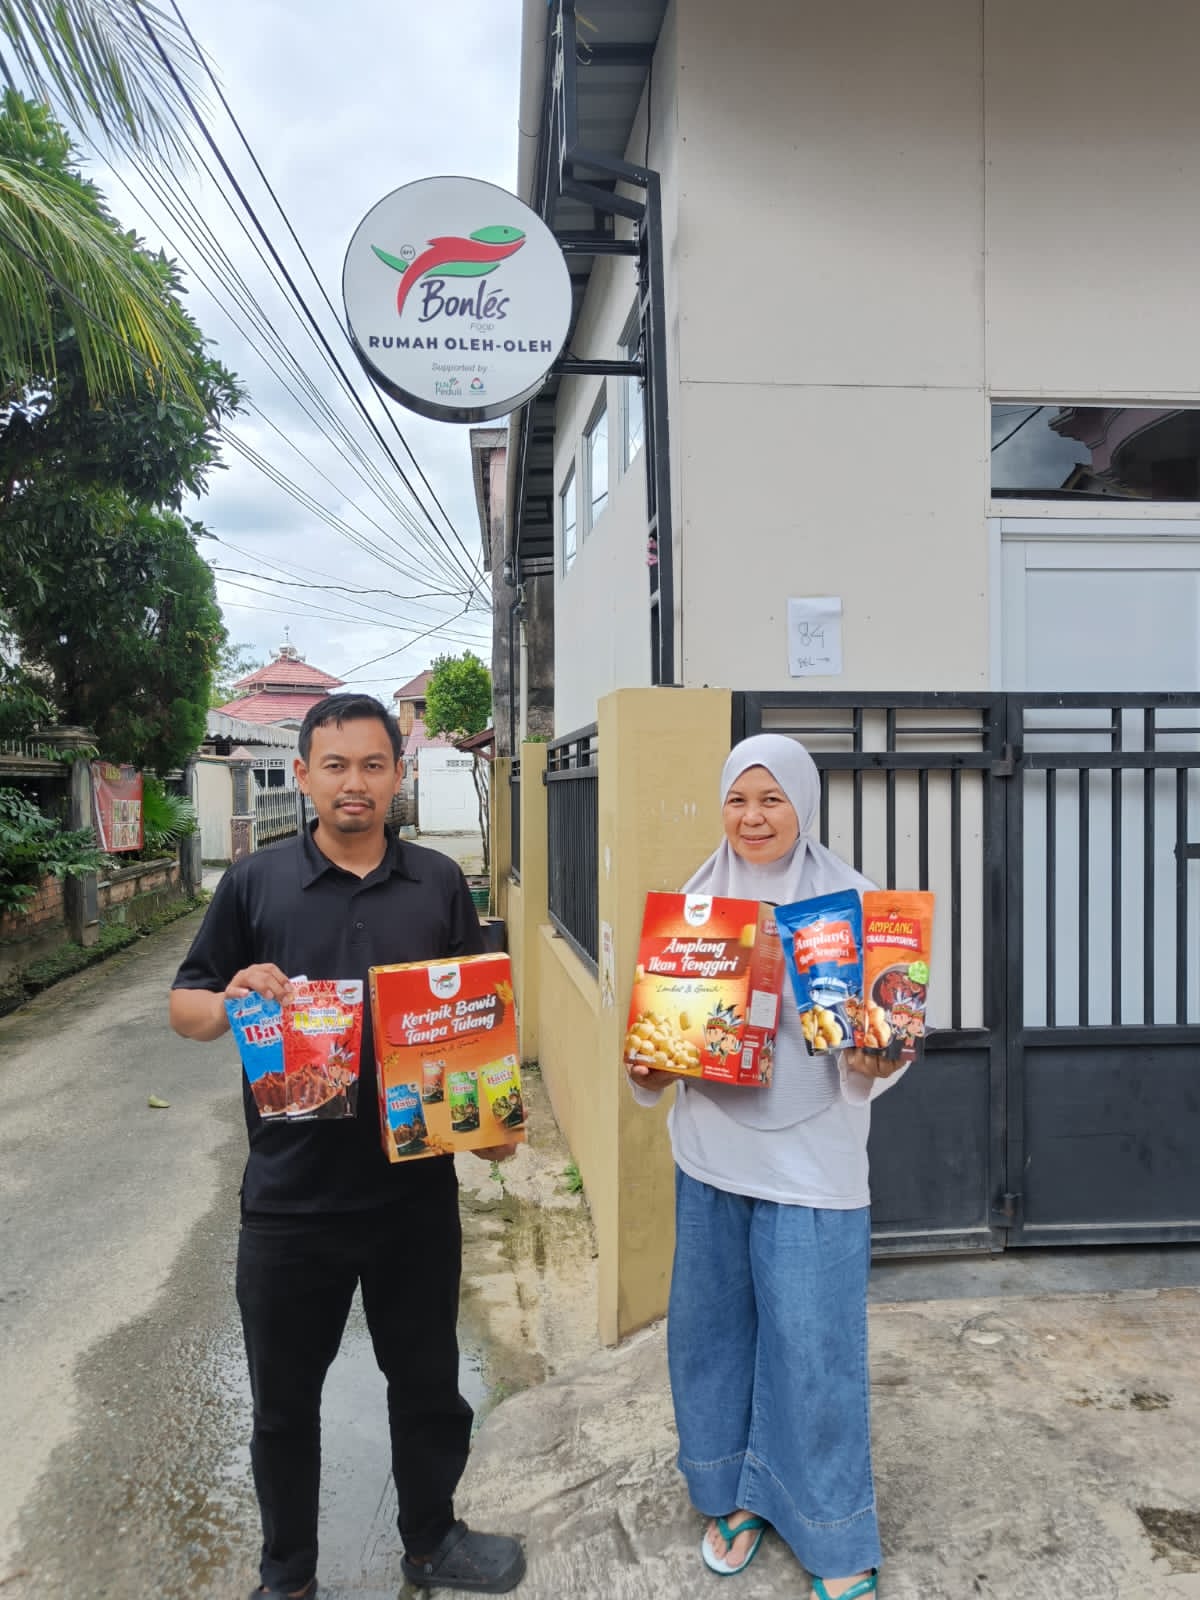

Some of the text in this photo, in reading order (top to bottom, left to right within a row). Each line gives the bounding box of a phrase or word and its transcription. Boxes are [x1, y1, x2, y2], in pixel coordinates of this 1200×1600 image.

[418, 279, 510, 323] Bonlés
[470, 322, 495, 331] FOOD
[369, 335, 552, 353] RUMAH OLEH-OLEH
[432, 362, 488, 375] Supported by
[798, 621, 825, 648] 84
[662, 938, 727, 958] Amplang
[648, 956, 740, 977] Ikan Tenggiri
[401, 994, 497, 1030] Keripik Bawis
[405, 1013, 496, 1045] Tanpa Tulang
